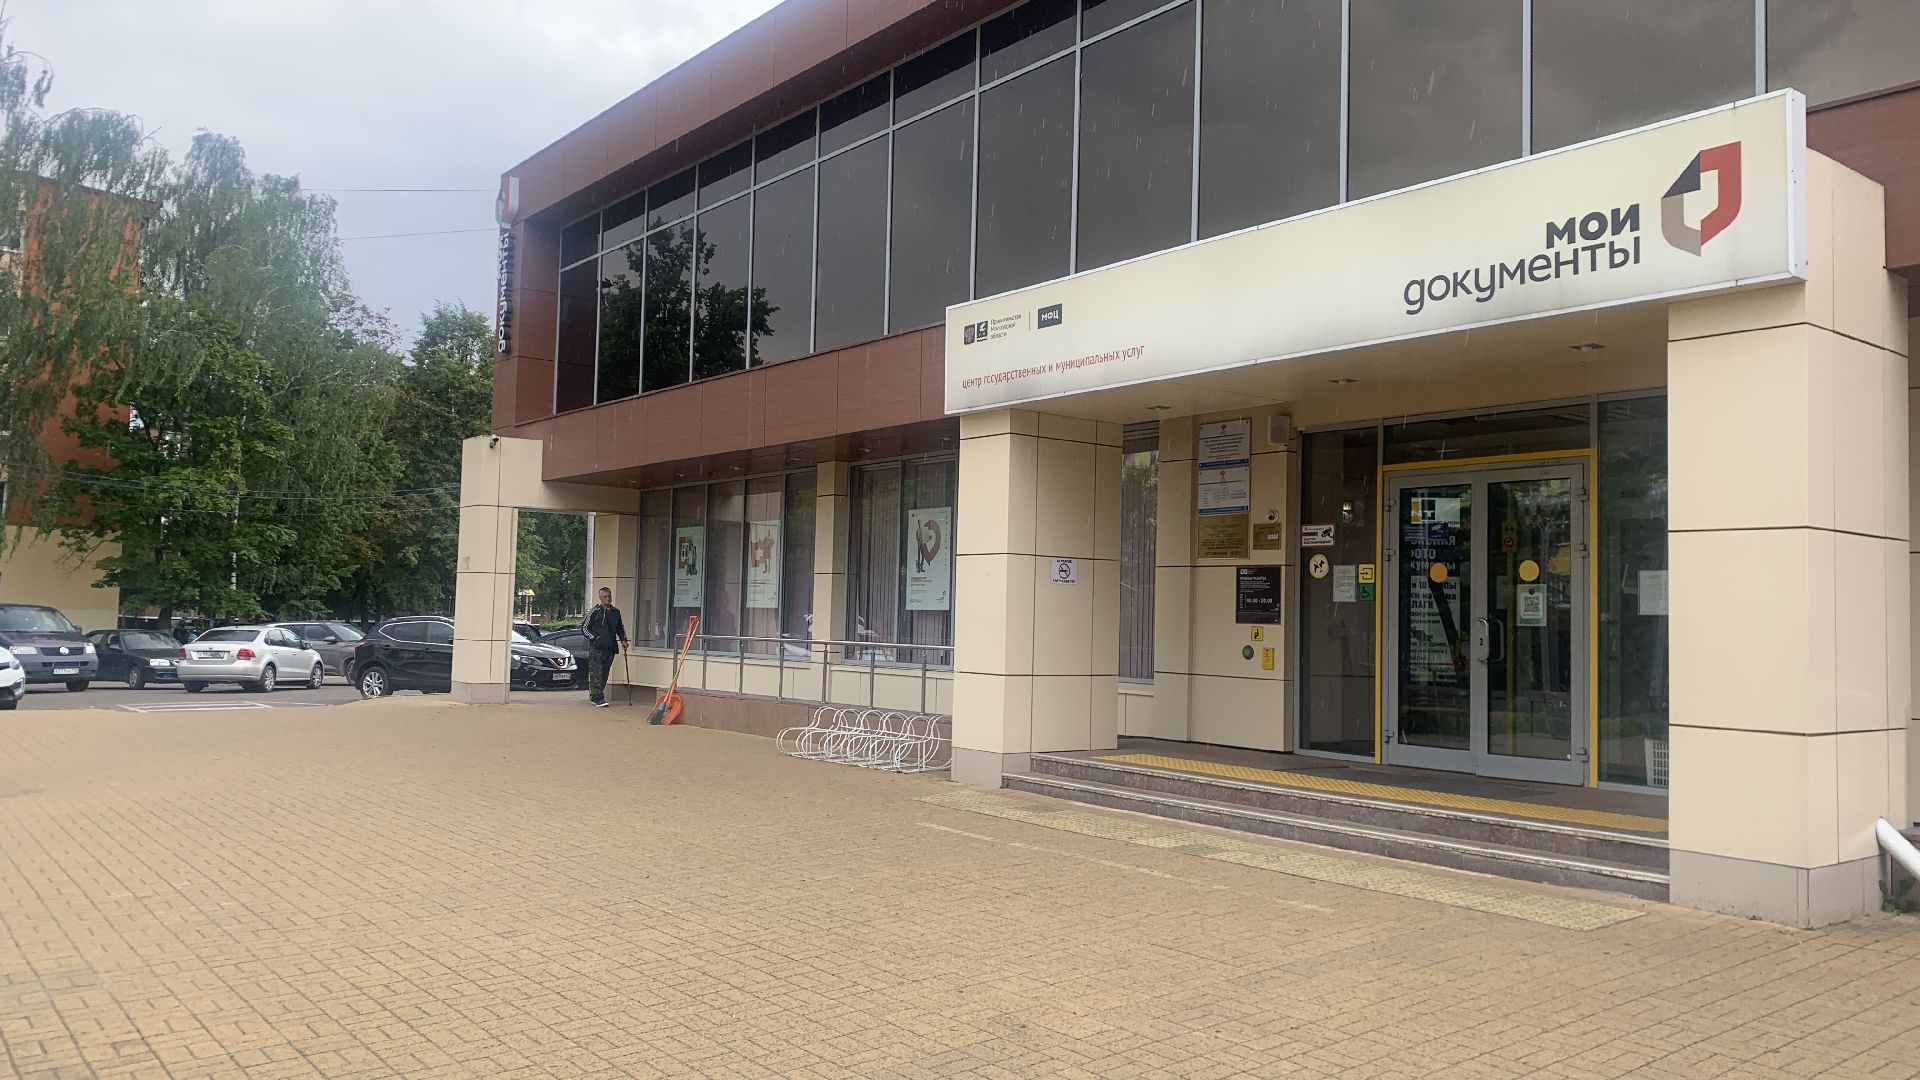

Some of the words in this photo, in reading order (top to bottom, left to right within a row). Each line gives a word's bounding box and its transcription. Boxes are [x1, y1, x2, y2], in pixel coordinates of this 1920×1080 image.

[1403, 236, 1641, 316] документы
[962, 376, 982, 389] центр
[983, 364, 1047, 386] государственных
[1048, 365, 1053, 373] и
[1055, 351, 1121, 374] муниципальных
[1122, 345, 1145, 361] услуг
